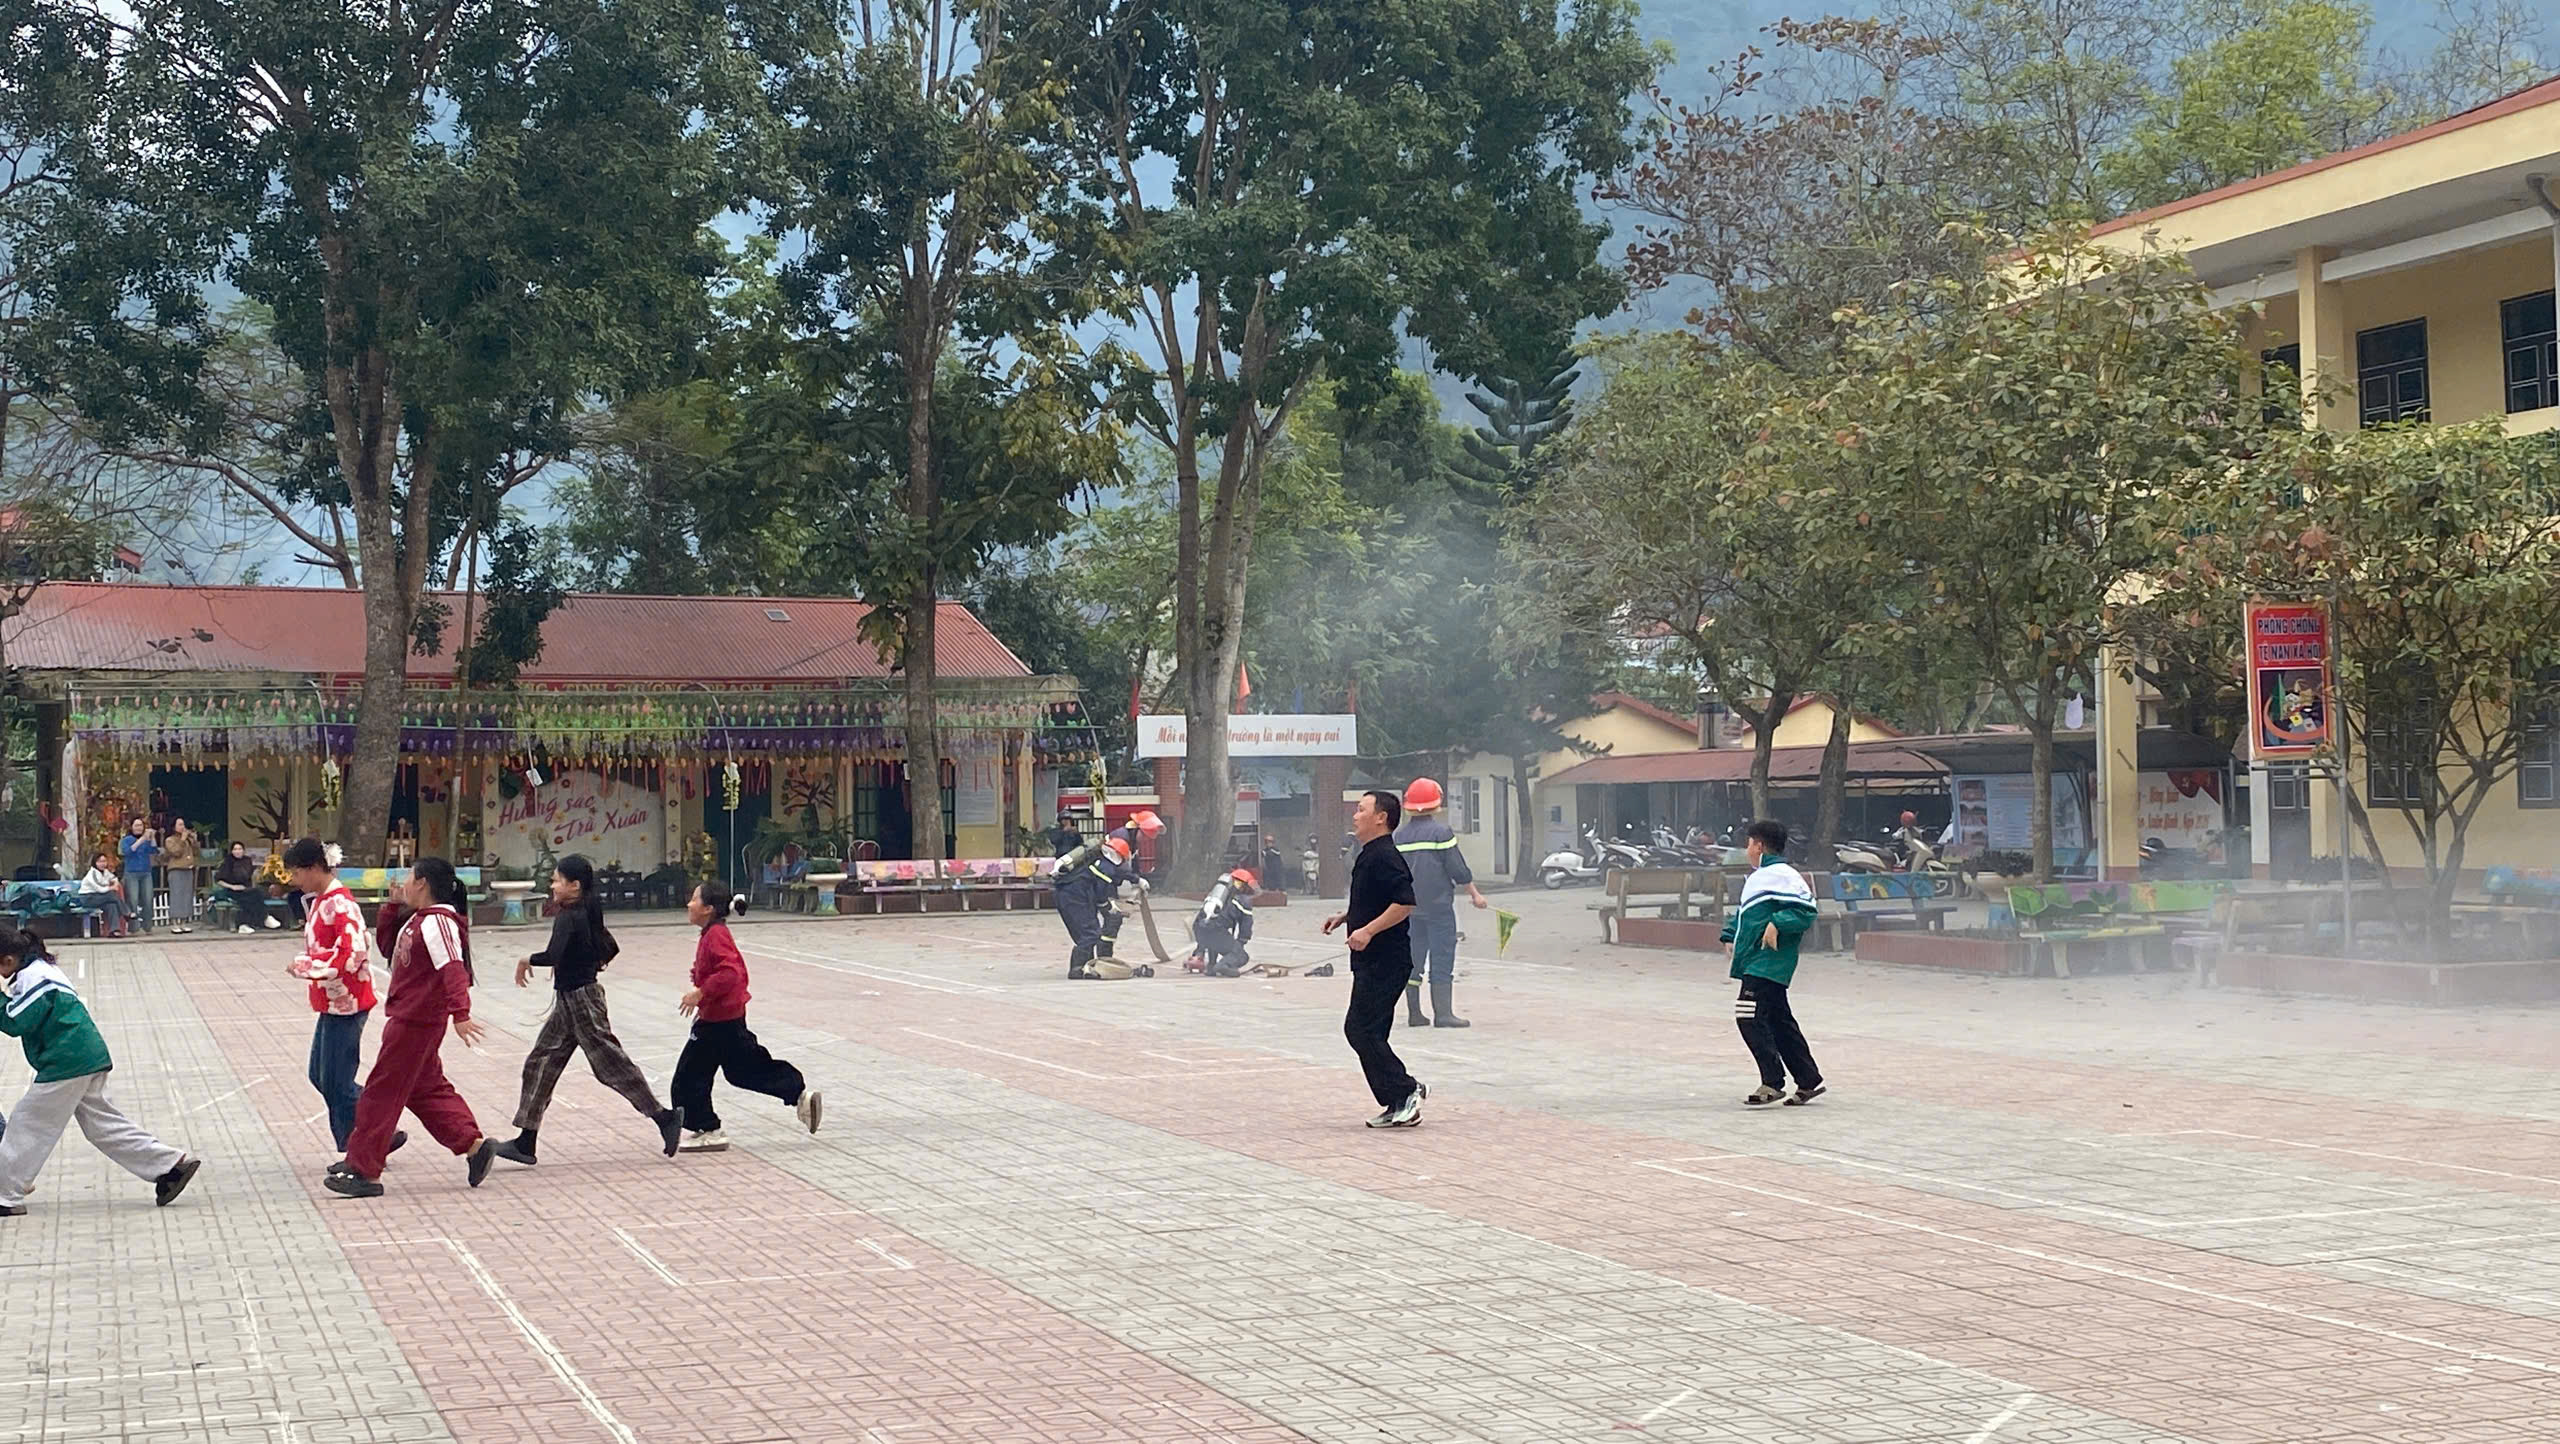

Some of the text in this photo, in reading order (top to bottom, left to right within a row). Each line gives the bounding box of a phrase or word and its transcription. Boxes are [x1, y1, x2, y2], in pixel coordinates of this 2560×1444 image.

[2257, 614, 2288, 634] PHÒNG
[1263, 727, 1273, 742] là
[1275, 728, 1294, 745] một
[1296, 728, 1321, 746] ngày
